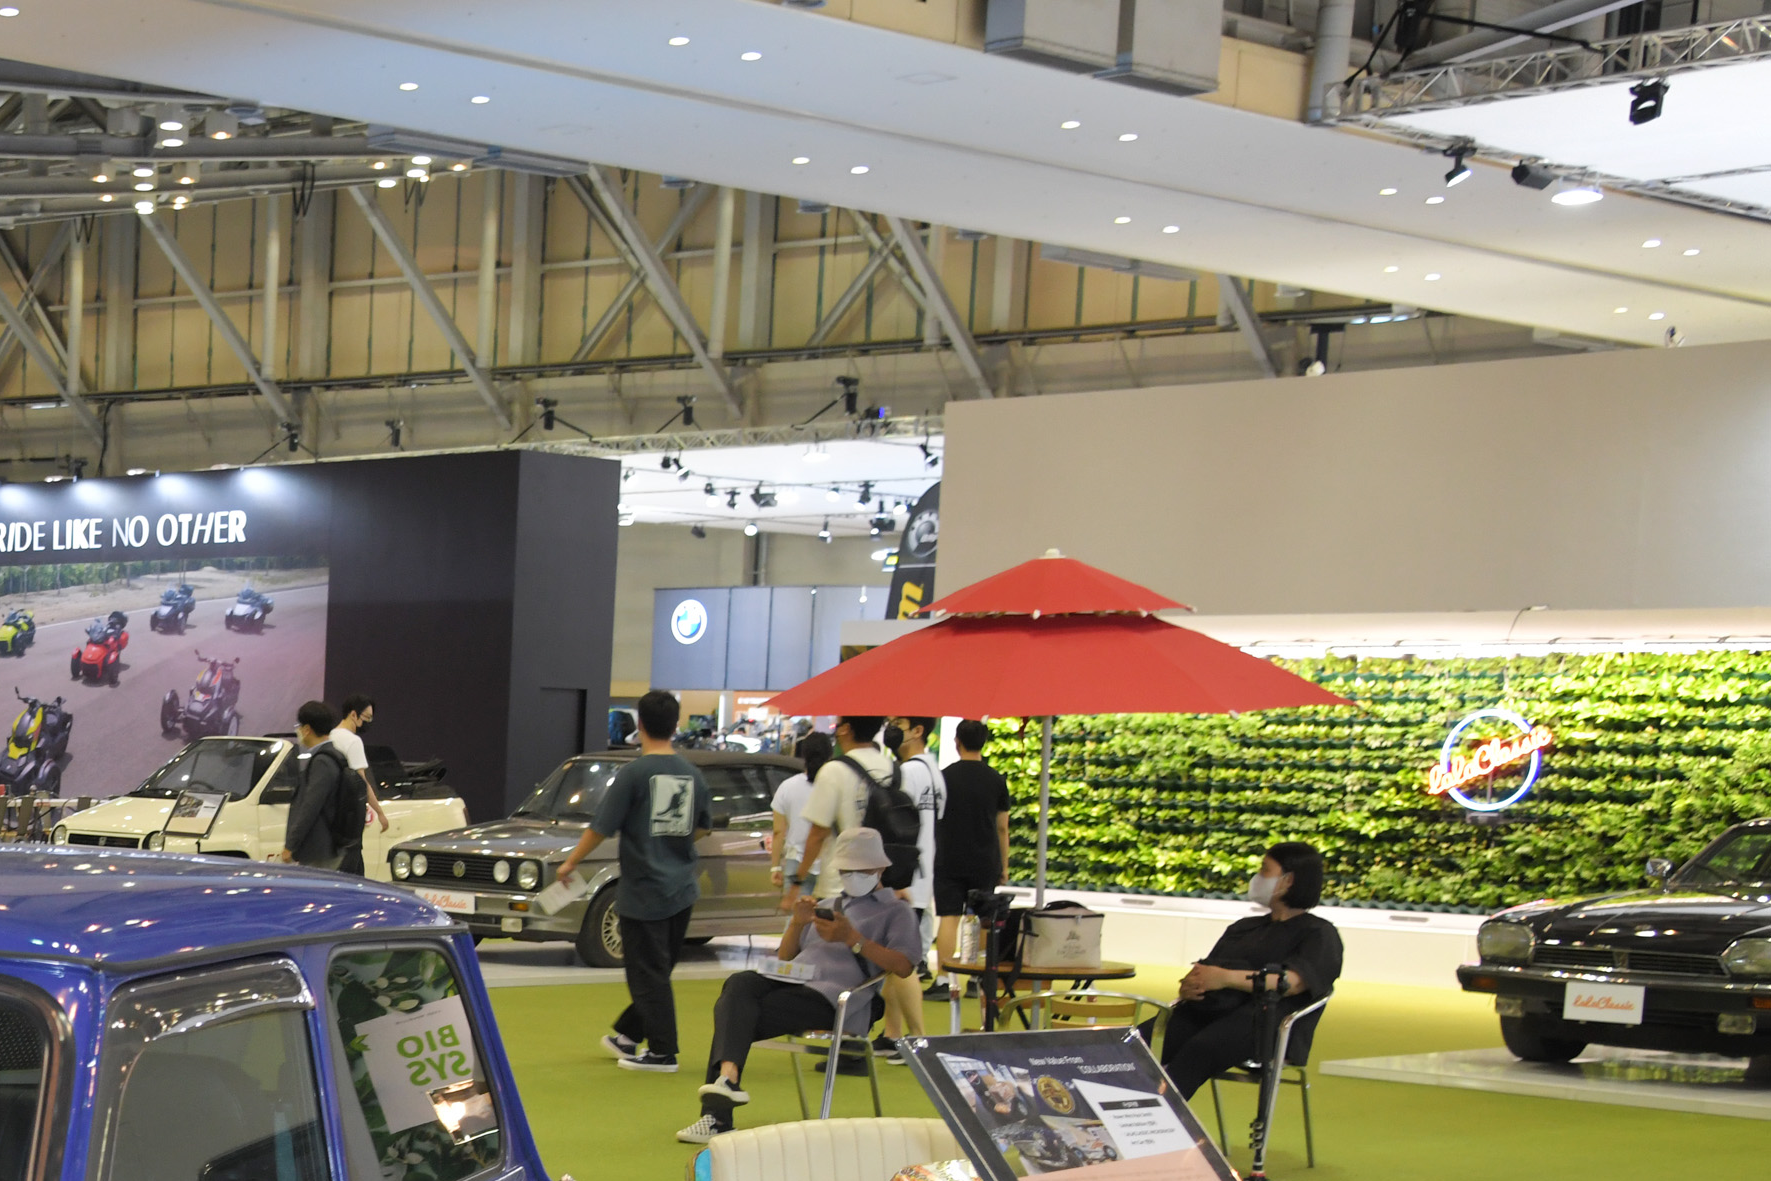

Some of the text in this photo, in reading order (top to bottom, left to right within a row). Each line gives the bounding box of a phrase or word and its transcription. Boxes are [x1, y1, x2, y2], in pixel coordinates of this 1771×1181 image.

[53, 518, 103, 550] LIKE
[112, 515, 149, 548] NO
[156, 510, 247, 547] OTHER
